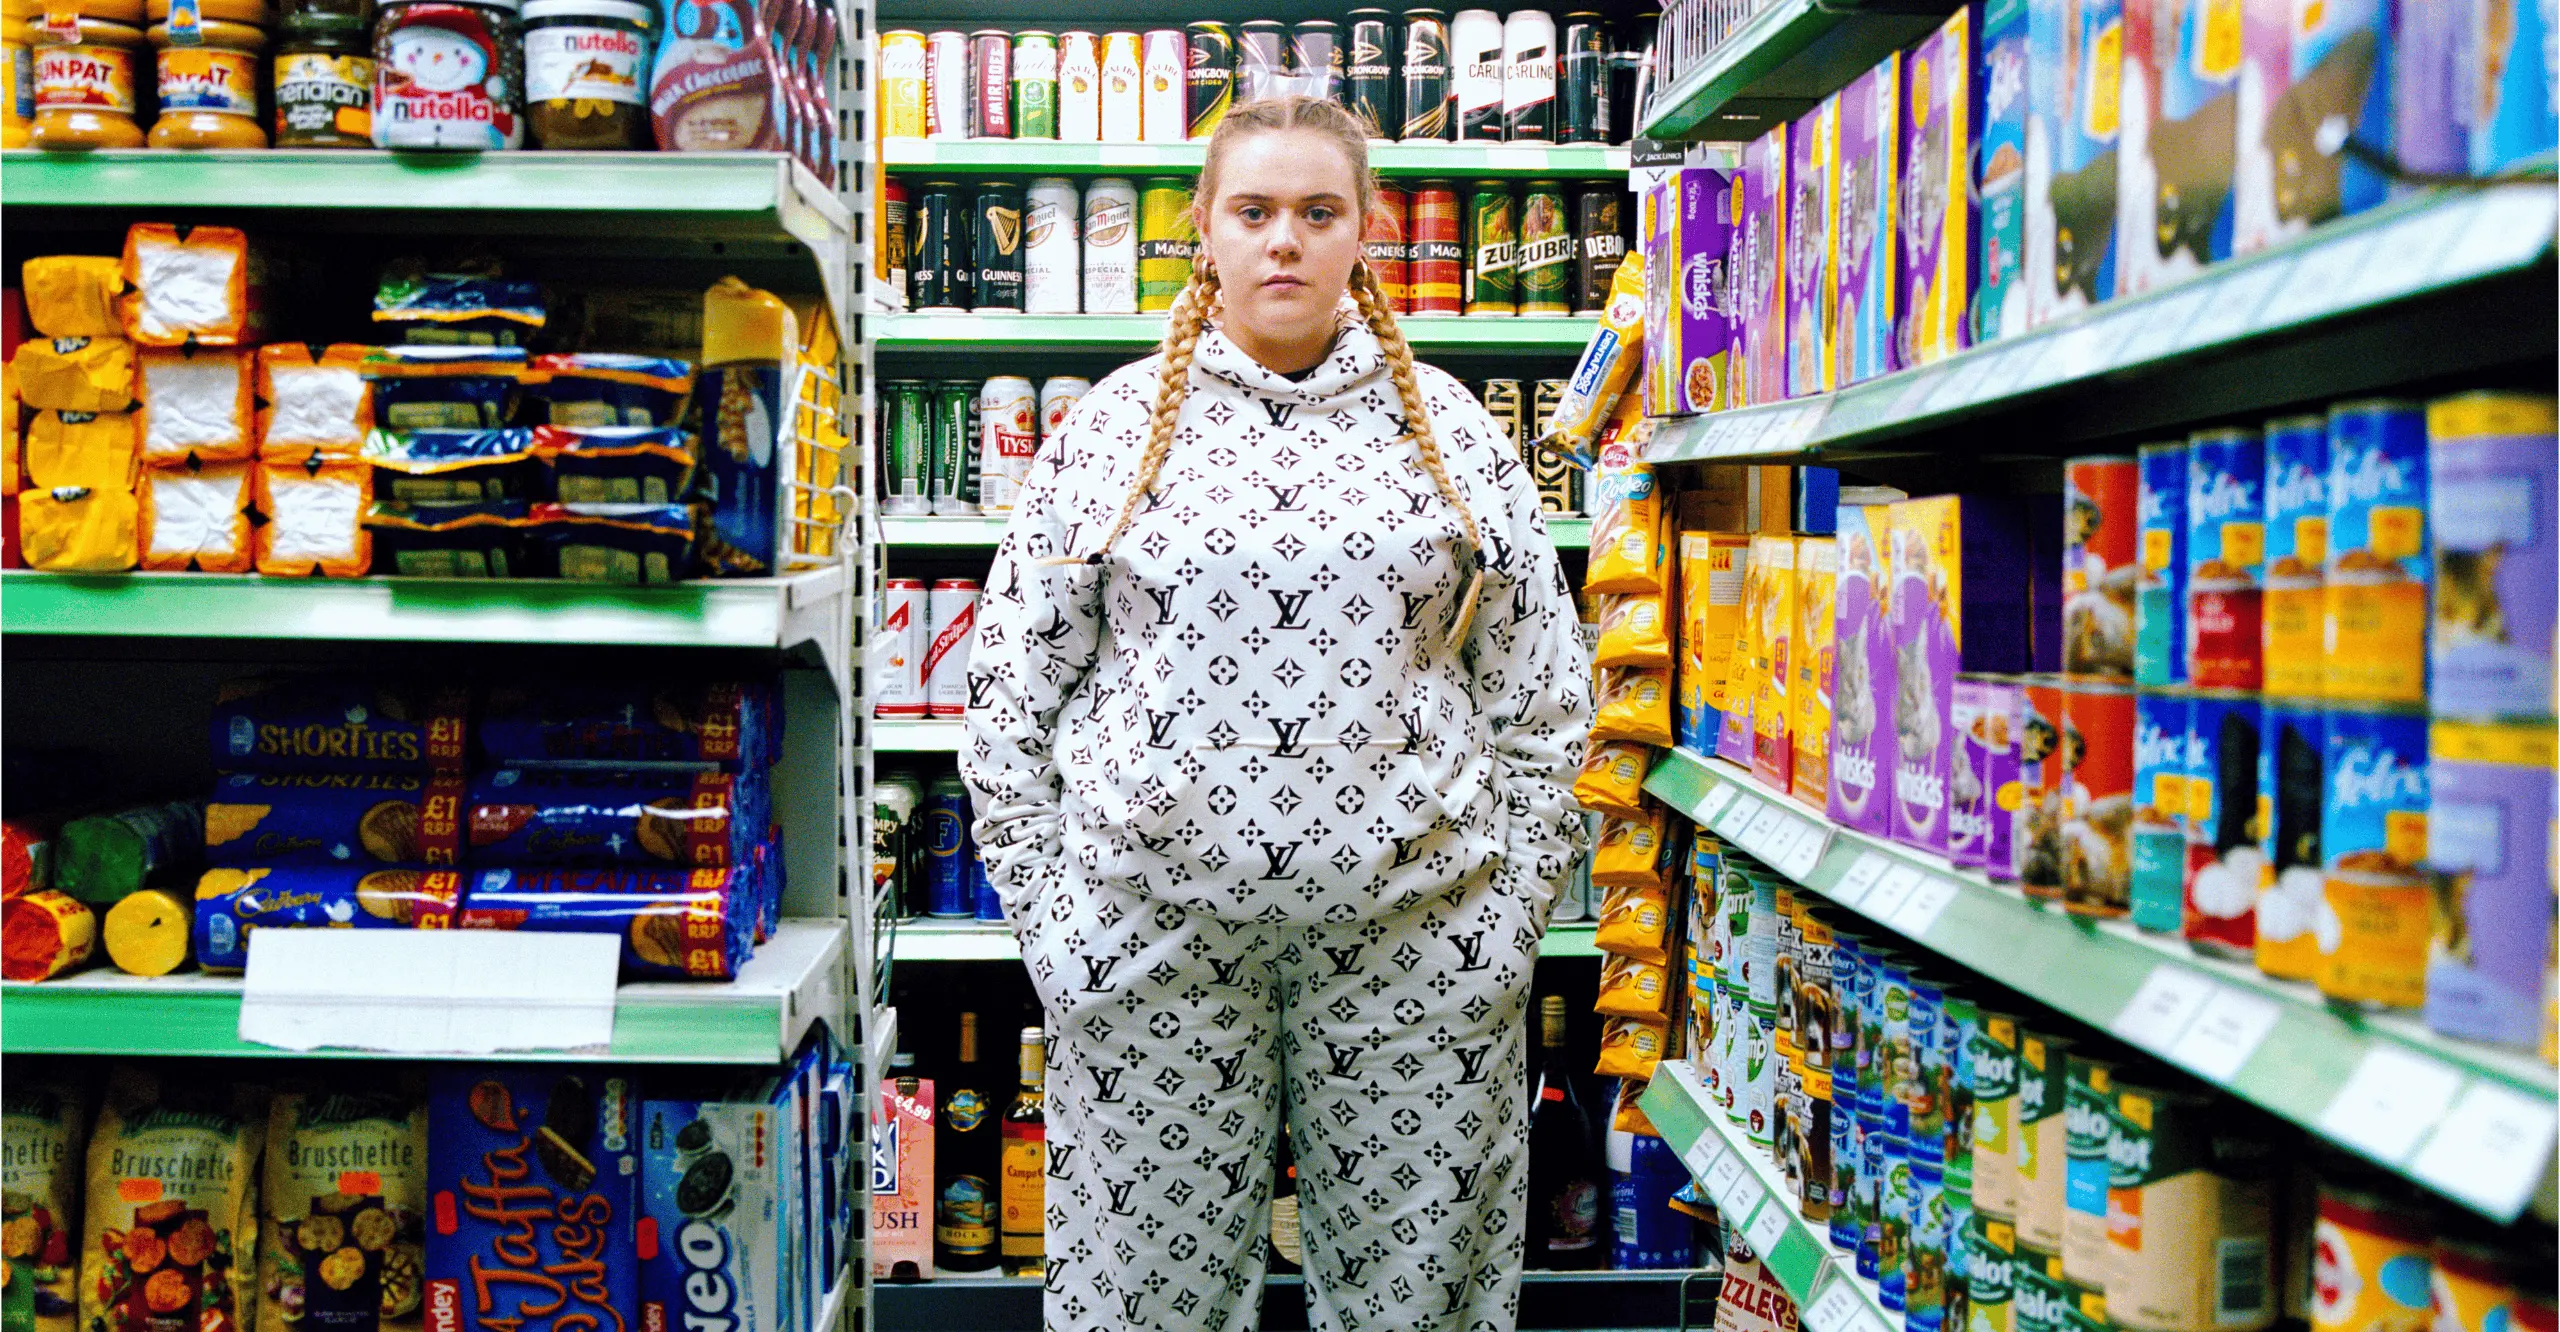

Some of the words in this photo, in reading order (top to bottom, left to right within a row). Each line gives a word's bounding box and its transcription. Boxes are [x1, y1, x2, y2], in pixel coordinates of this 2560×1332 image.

[564, 29, 638, 55] nutella
[68, 59, 112, 80] PAT
[1187, 67, 1231, 80] RONGBOW
[1346, 65, 1390, 78] STRONGBOW
[1401, 64, 1446, 78] STRONGBOW
[1468, 63, 1502, 79] CARLI
[1506, 63, 1554, 82] CARLING
[988, 46, 1005, 126] SMIRNOFF
[394, 98, 488, 124] nutella
[1097, 207, 1130, 226] Miguel
[1368, 245, 1405, 258] GNERS
[982, 268, 1022, 283] GUINNESS
[1693, 251, 1712, 321] whiskas
[1000, 436, 1037, 455] TYSK
[1598, 475, 1652, 505] Rodeo
[430, 717, 460, 743] £1
[258, 722, 420, 762] SHORTIES
[424, 795, 456, 820] £1
[688, 949, 719, 971] £1
[894, 1095, 931, 1121] £4.99
[112, 1148, 234, 1181] Bruschette
[288, 1138, 414, 1168] Bruschette
[460, 1135, 567, 1316] Jaffa
[872, 1211, 919, 1230] USH
